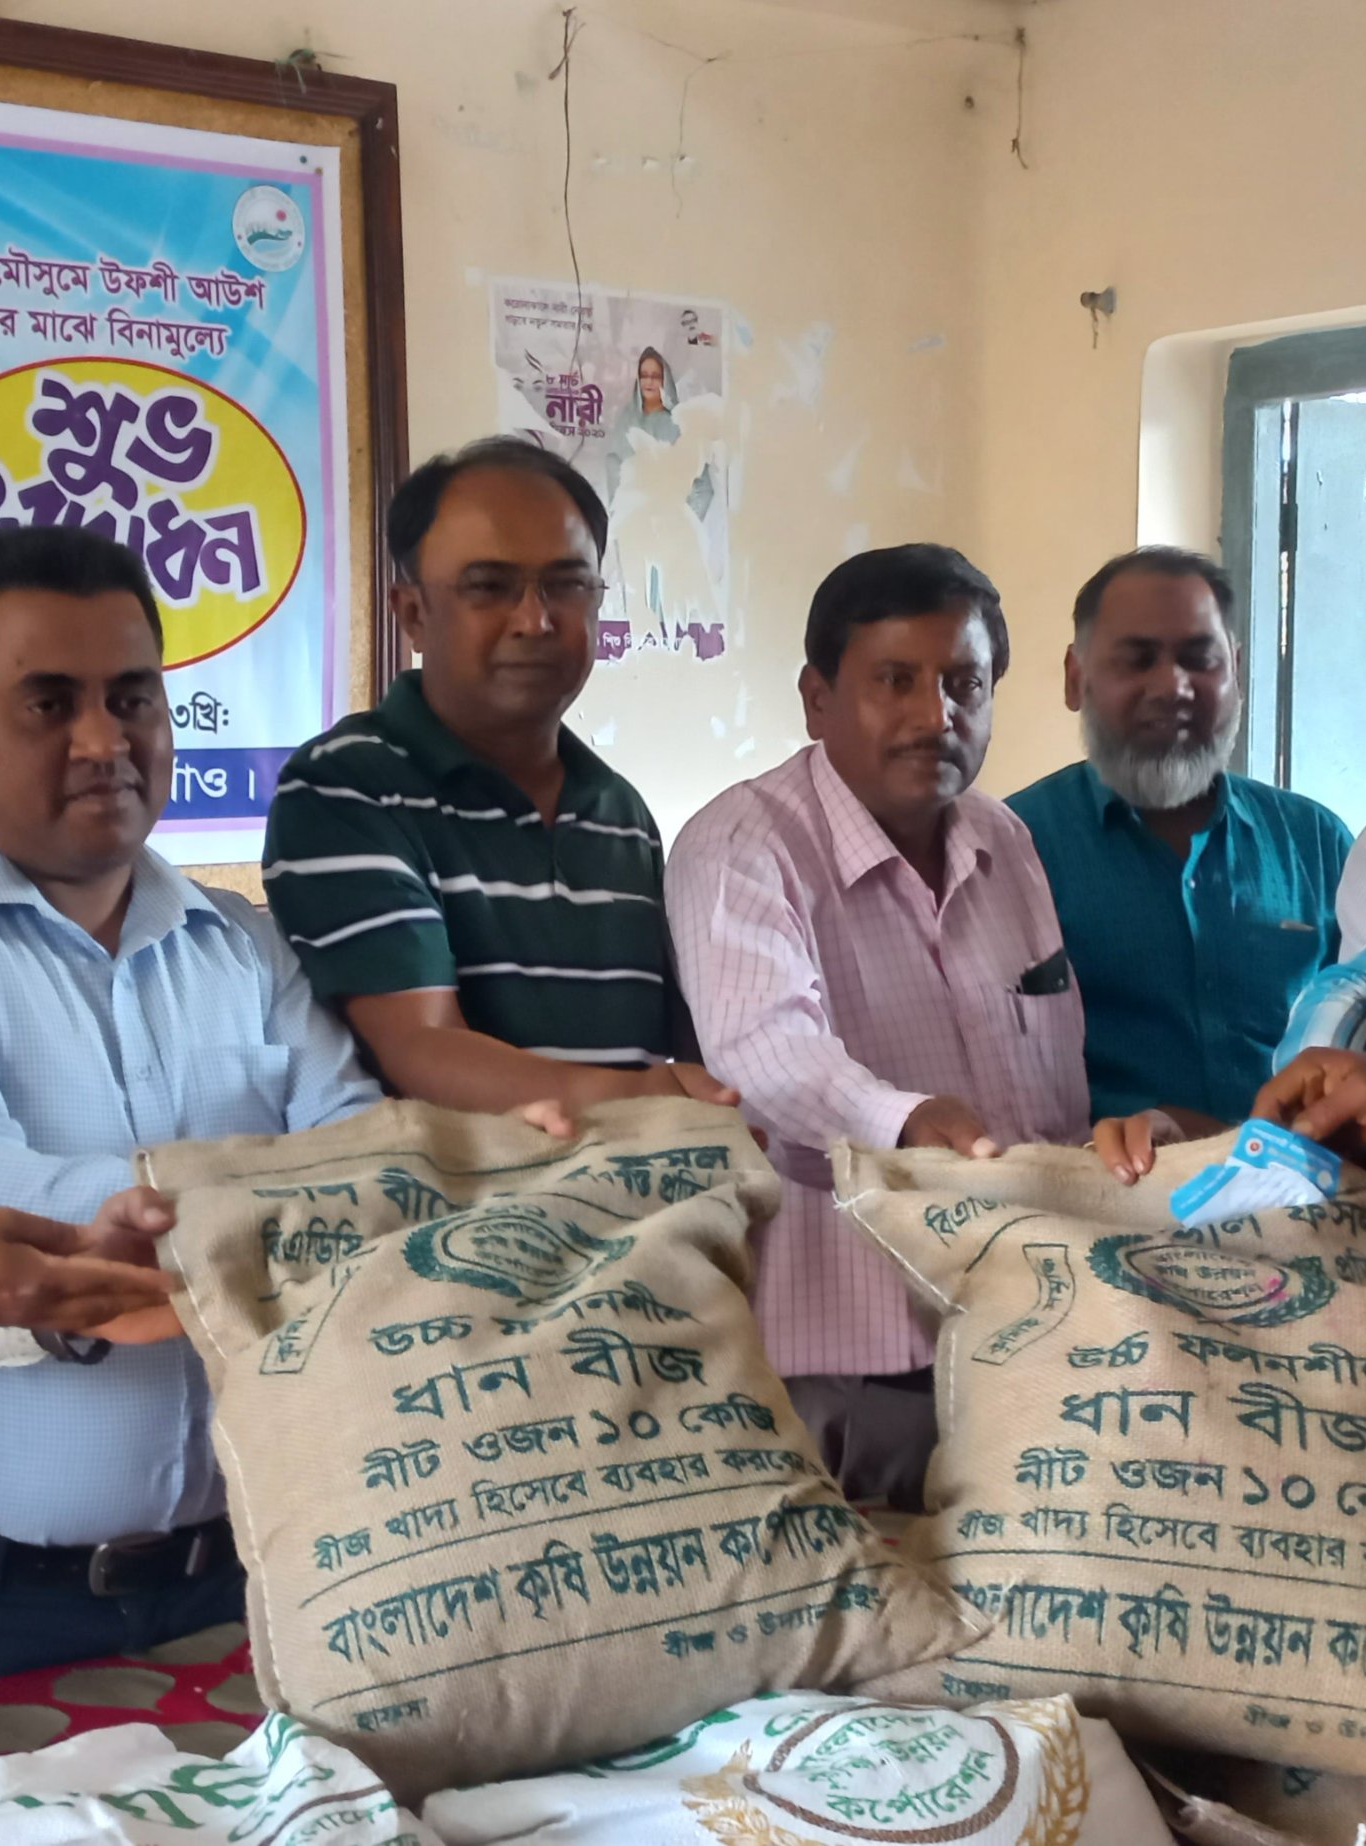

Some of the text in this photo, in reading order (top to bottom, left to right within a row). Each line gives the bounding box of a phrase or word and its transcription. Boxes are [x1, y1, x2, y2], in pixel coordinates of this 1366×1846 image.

[99, 257, 178, 302] উফশী
[188, 271, 264, 309] আউশ
[28, 310, 97, 344] মাঝে
[107, 308, 229, 357] বিনামুল্যে
[32, 378, 212, 511] শুভ
[545, 384, 603, 428] নারী
[393, 1325, 707, 1419] ধান বীজ
[359, 1391, 780, 1491] নীট ওজন ১০ কেজি
[1060, 1387, 1198, 1437] ধান
[314, 1527, 371, 1572] বীজ
[385, 1498, 458, 1542] খাদ্য
[471, 1470, 590, 1523] হিসেবে
[597, 1449, 710, 1495] ব্যবহার
[1014, 1446, 1090, 1492] নীট
[1111, 1459, 1225, 1499] ওজন
[1241, 1466, 1316, 1509] ১০
[956, 1508, 1007, 1541] বীজ
[1020, 1507, 1089, 1539] খাদ্য
[1102, 1503, 1221, 1549] হিসেবে
[1232, 1524, 1348, 1571] ব্যবহার
[322, 1564, 508, 1665] বাংলাদেশ
[508, 1539, 591, 1620] কৃষি
[590, 1516, 712, 1598] উন্নয়ন
[1116, 1582, 1192, 1659] কৃষি
[1202, 1592, 1316, 1670] উন্নয়ন
